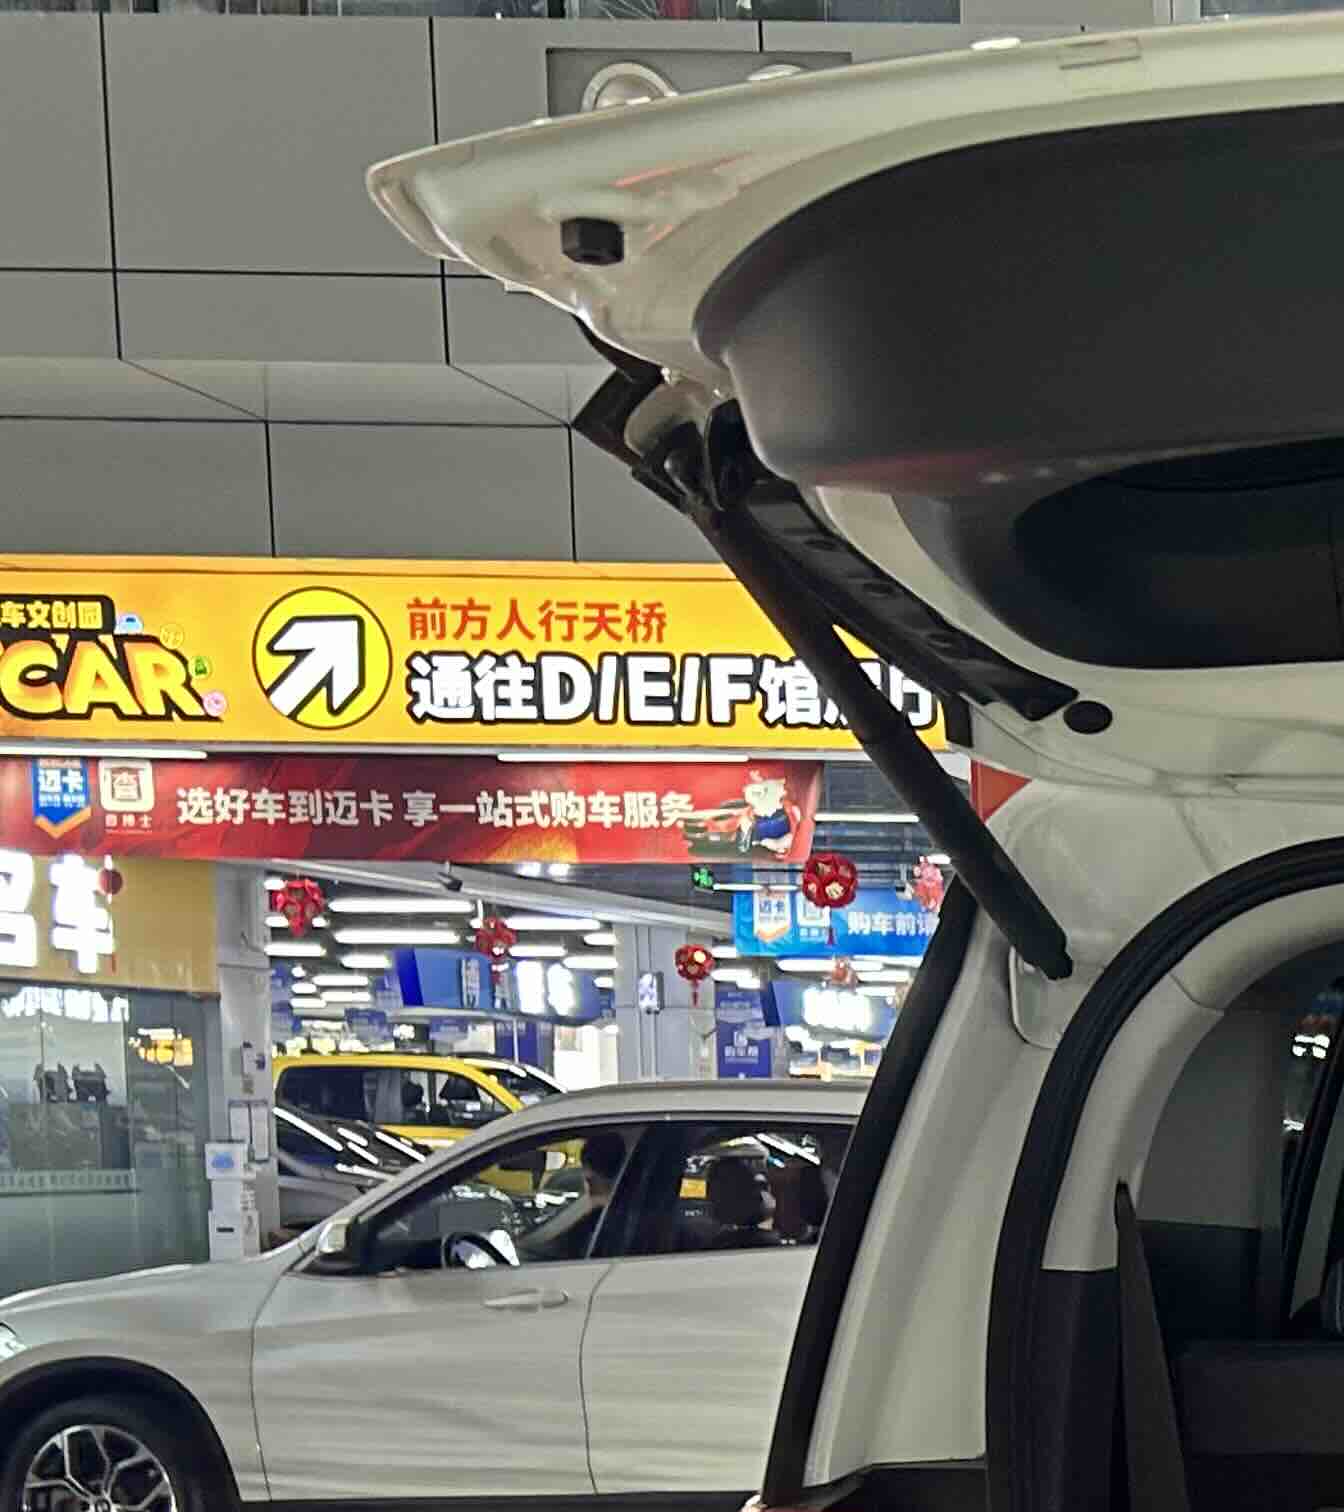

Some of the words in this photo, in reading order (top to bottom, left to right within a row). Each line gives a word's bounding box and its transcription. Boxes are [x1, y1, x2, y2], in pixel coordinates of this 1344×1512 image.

[407, 598, 667, 643] 前方人行天桥
[177, 788, 393, 827] 选好车到迈卡
[403, 789, 694, 829] 享一站式购车服务
